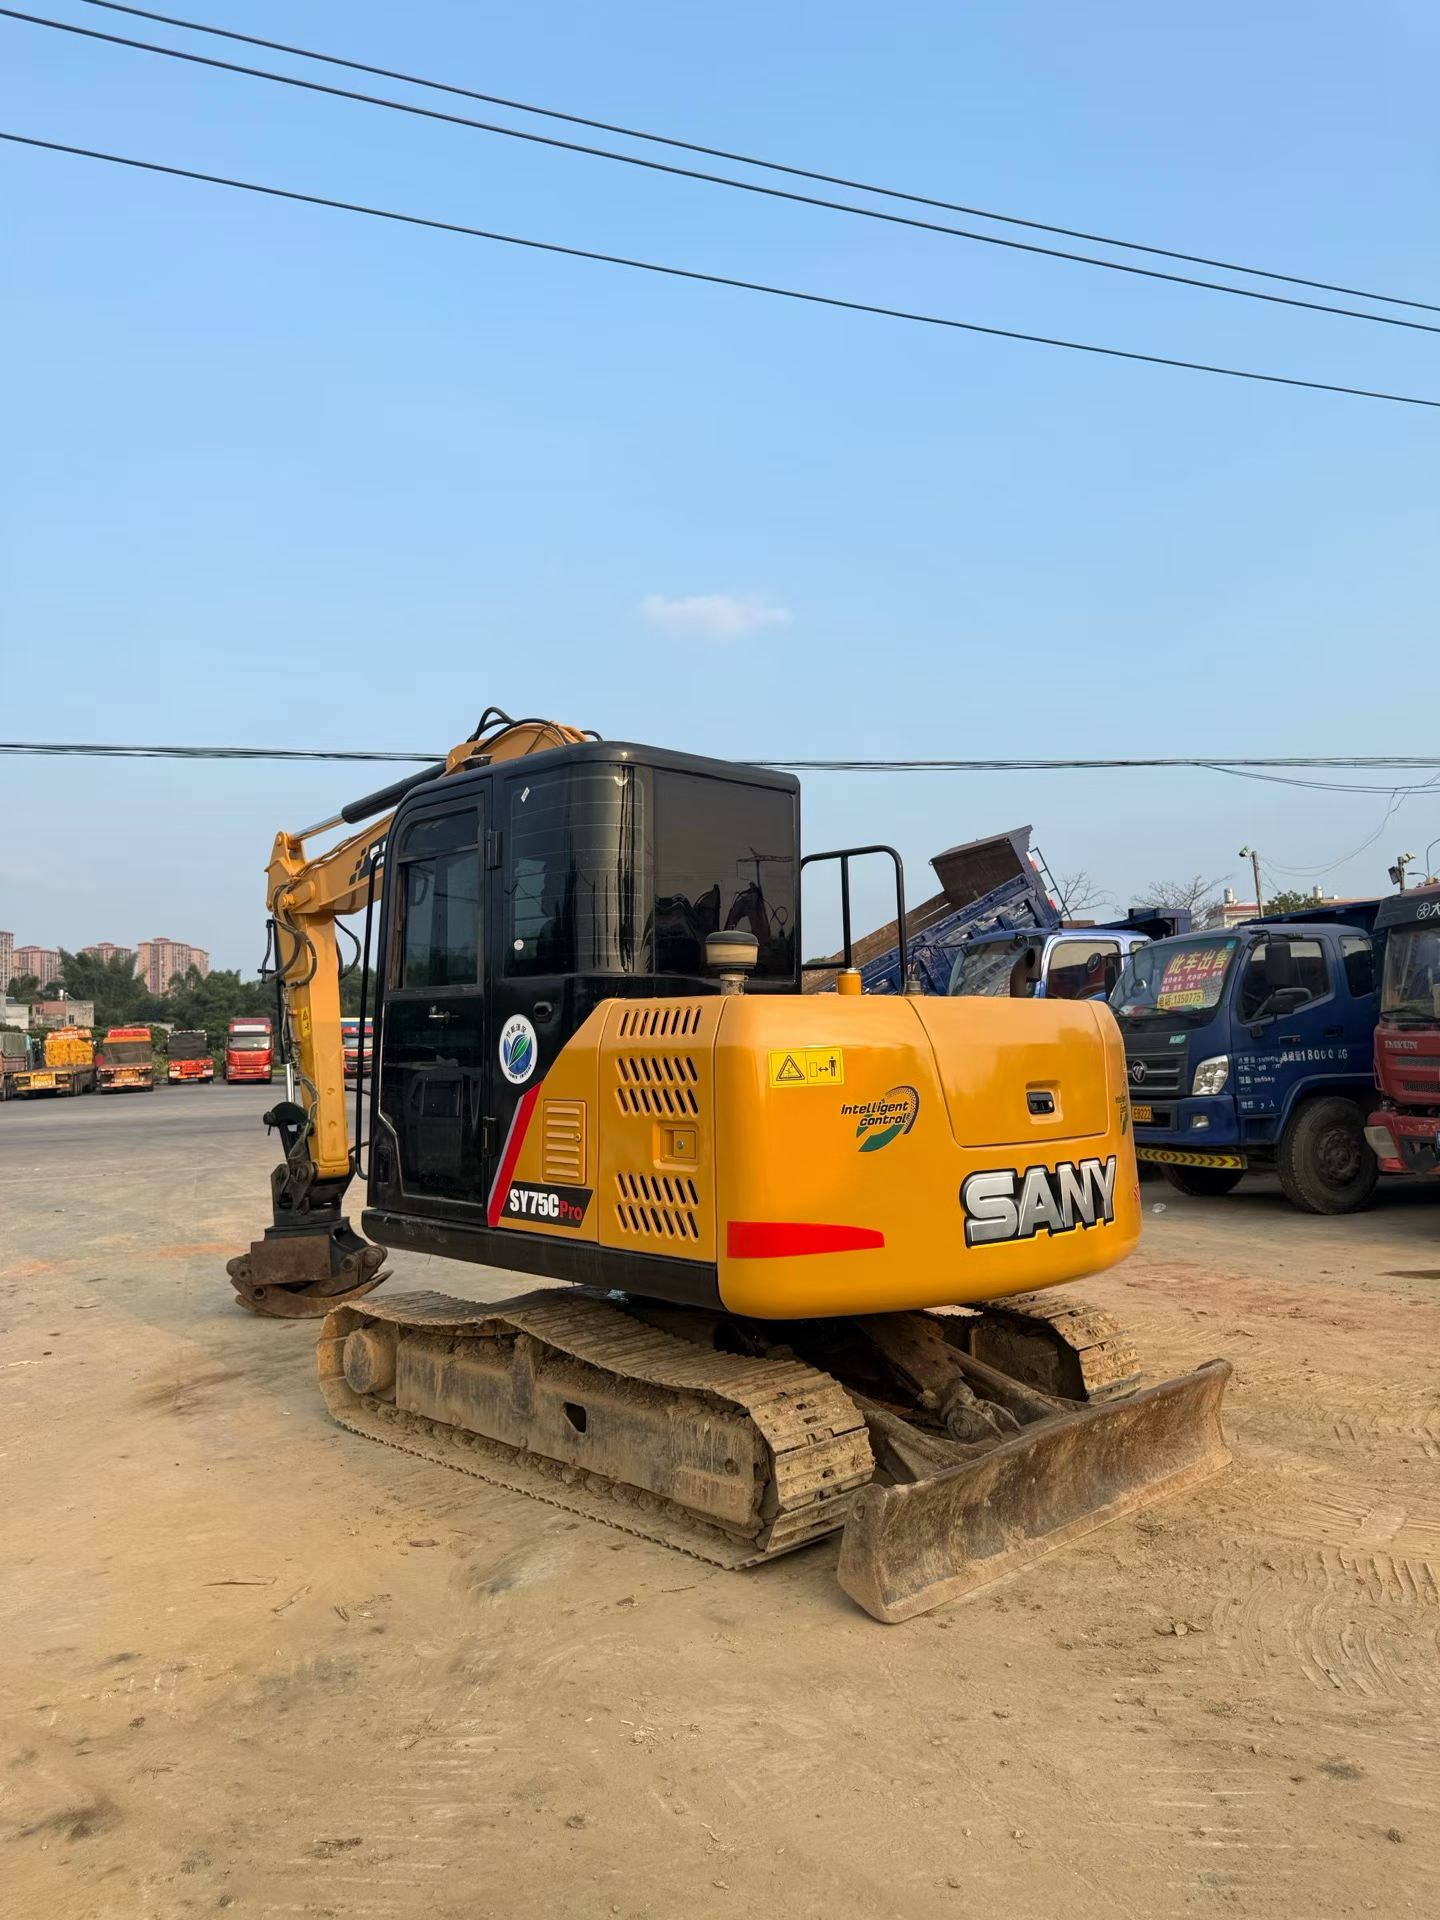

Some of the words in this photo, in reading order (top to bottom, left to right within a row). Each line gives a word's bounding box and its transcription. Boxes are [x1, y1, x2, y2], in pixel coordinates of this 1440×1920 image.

[1167, 949, 1232, 975] 此车出售
[840, 1099, 910, 1116] Intelligent
[859, 1113, 907, 1127] control
[509, 1188, 560, 1217] SY75C
[559, 1200, 583, 1220] Pro
[961, 1156, 1116, 1247] SANY
